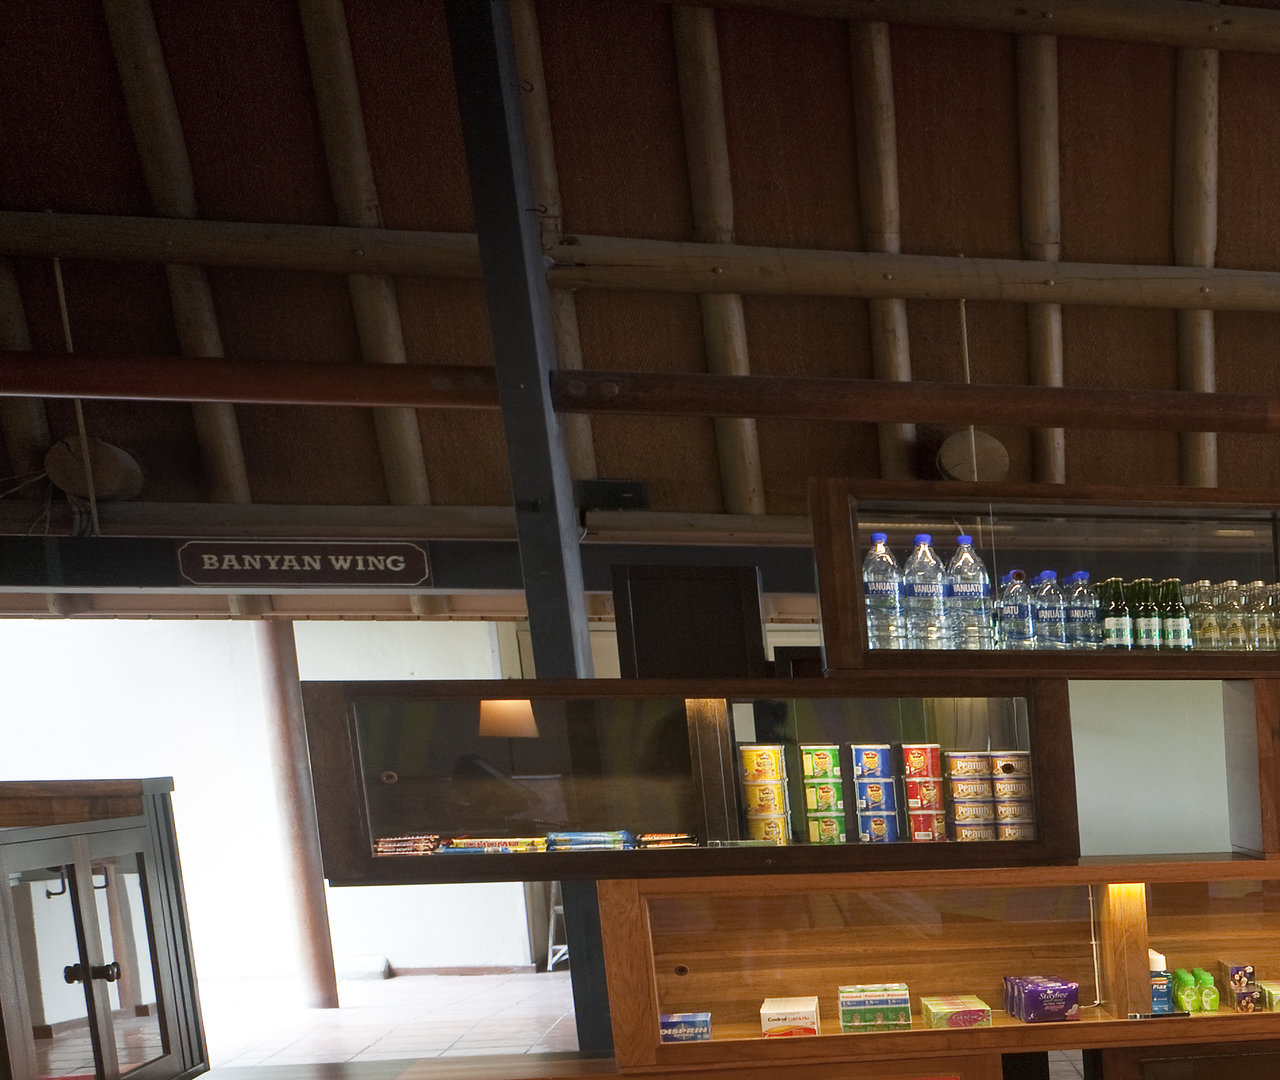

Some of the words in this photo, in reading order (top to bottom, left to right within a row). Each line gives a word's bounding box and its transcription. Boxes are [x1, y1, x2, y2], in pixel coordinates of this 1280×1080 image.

[202, 554, 322, 571] BANYAN
[328, 555, 406, 572] WING
[868, 582, 899, 593] VANUATU
[914, 583, 944, 594] VANUATU
[953, 583, 983, 593] VANUATU
[1039, 991, 1068, 1001] Stayfree
[661, 1026, 708, 1036] DISPRIN
